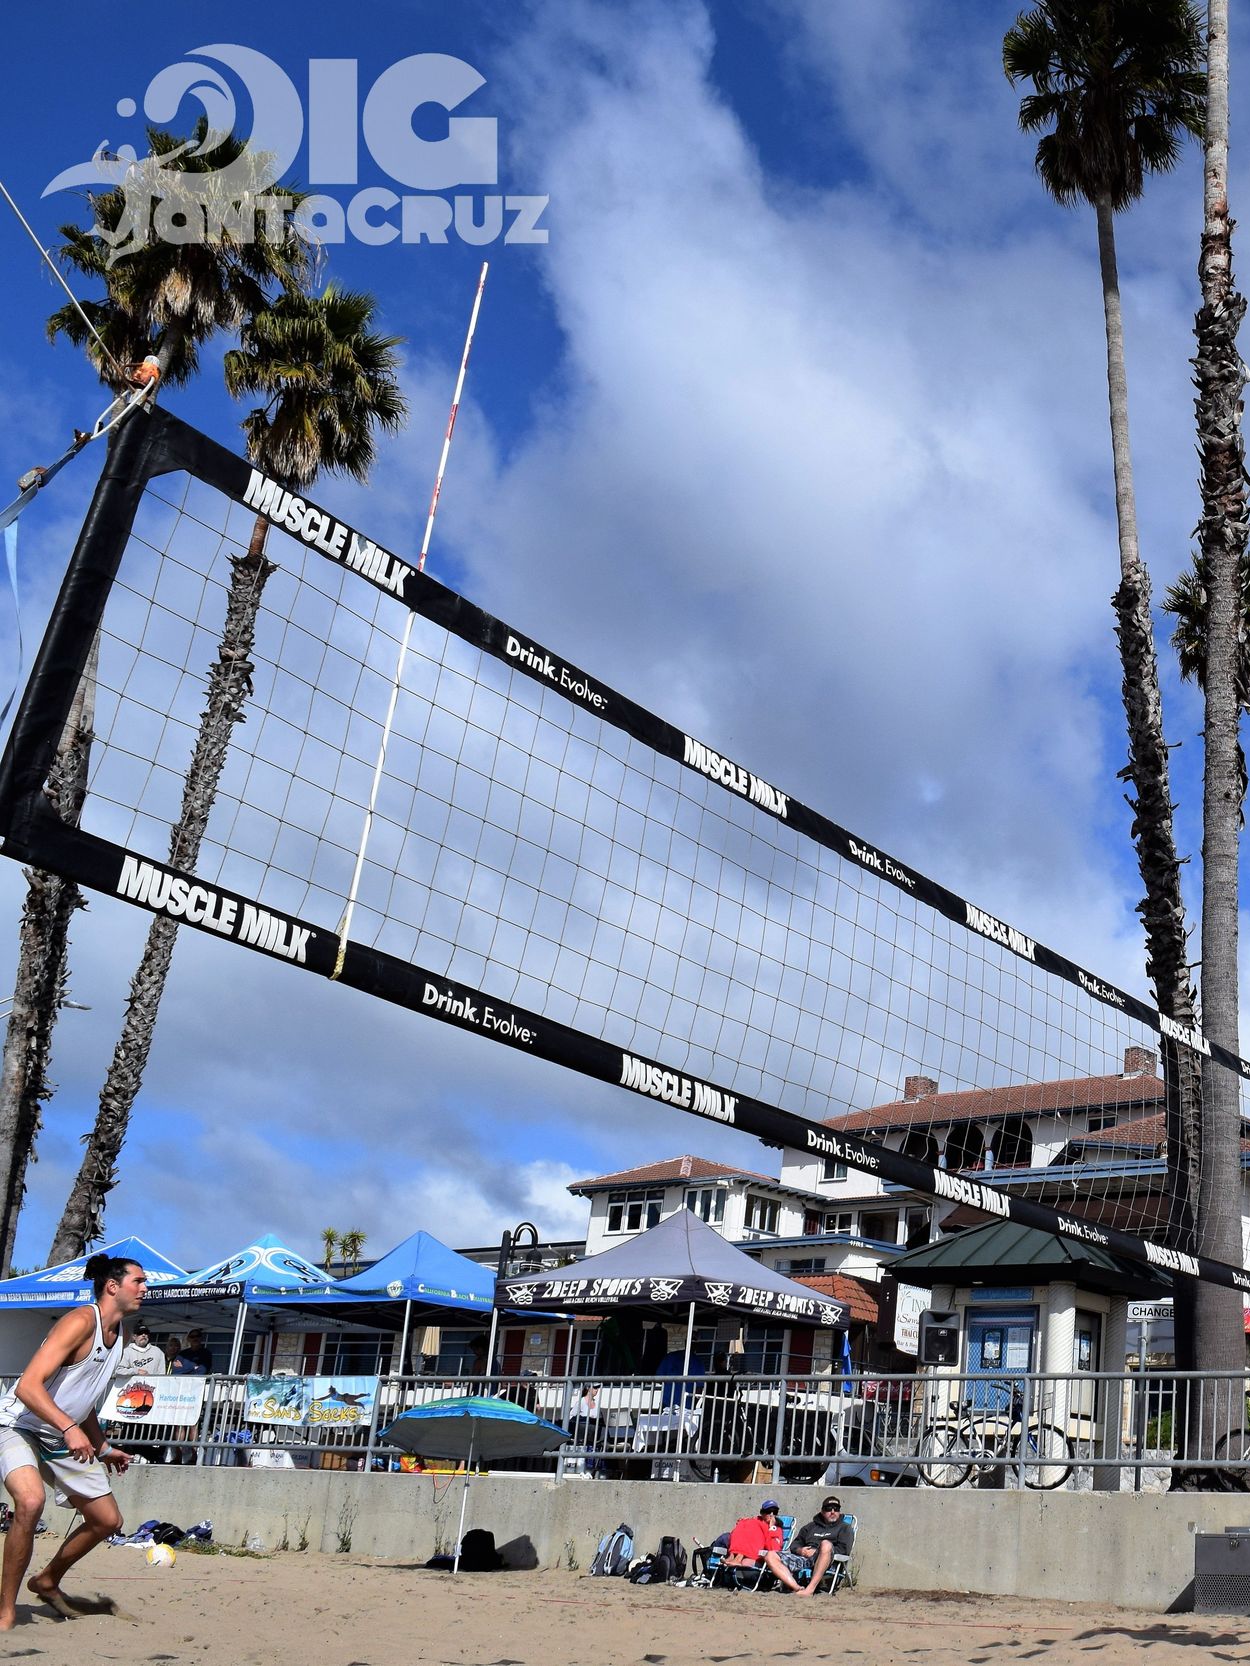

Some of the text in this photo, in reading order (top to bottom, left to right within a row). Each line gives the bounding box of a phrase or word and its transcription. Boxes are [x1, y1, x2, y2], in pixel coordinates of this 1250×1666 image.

[243, 469, 410, 597] MUSCLE MILK
[506, 635, 558, 681] Drink.
[684, 735, 787, 818] MUSCLE MILK
[849, 840, 884, 872] Drink.
[117, 855, 311, 963] MUSCLE MILK
[965, 902, 1036, 961] MUSCLE MILK
[422, 983, 479, 1024] Drink.
[1159, 1012, 1211, 1057] MUSCLE MILK
[620, 1053, 736, 1123] MUSCLE MILK
[807, 1129, 844, 1158] Drink.
[933, 1168, 1010, 1218] MUSCLE MILK
[1057, 1217, 1085, 1238] Drink.
[1144, 1240, 1200, 1276] MUSCLE MILK
[152, 1290, 163, 1299] FOR
[163, 1287, 191, 1298] HARDCORE
[191, 1287, 226, 1297] COMPETITION
[542, 1278, 645, 1297] 2DEEP SPORTS
[737, 1287, 815, 1315] 2DEEP SPORTS
[160, 1394, 196, 1402] Harbor Beach
[262, 1397, 301, 1420] SAND
[309, 1401, 359, 1422] SOCKS
